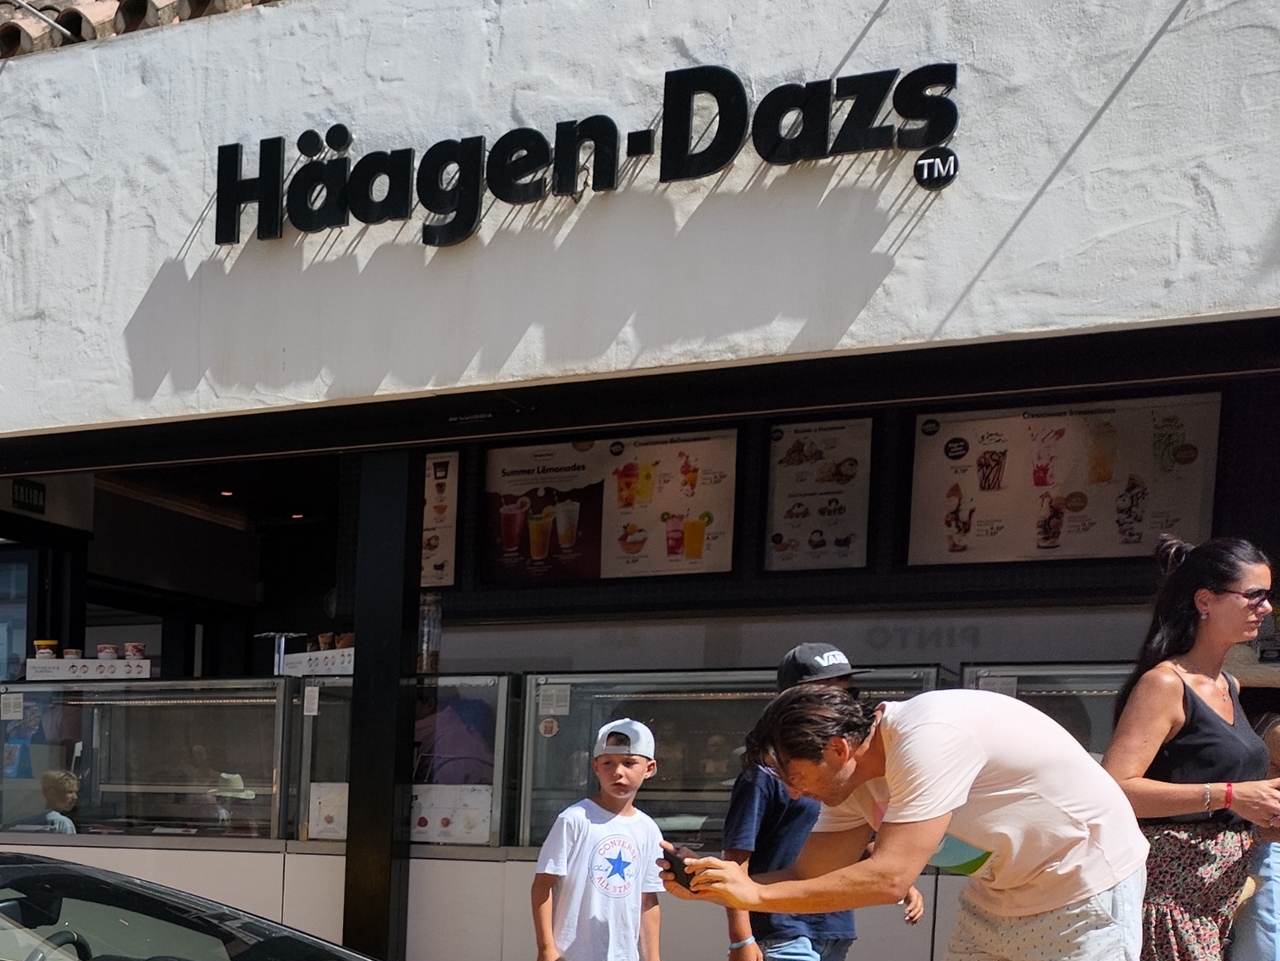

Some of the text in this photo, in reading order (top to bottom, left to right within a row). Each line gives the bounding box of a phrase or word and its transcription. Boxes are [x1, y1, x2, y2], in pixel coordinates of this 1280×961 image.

[215, 62, 958, 247] Häagen-Dazs
[918, 154, 955, 179] TM
[501, 462, 586, 477] Summer Lëmonades
[14, 483, 44, 507] SALIDA
[814, 650, 849, 667] VAN
